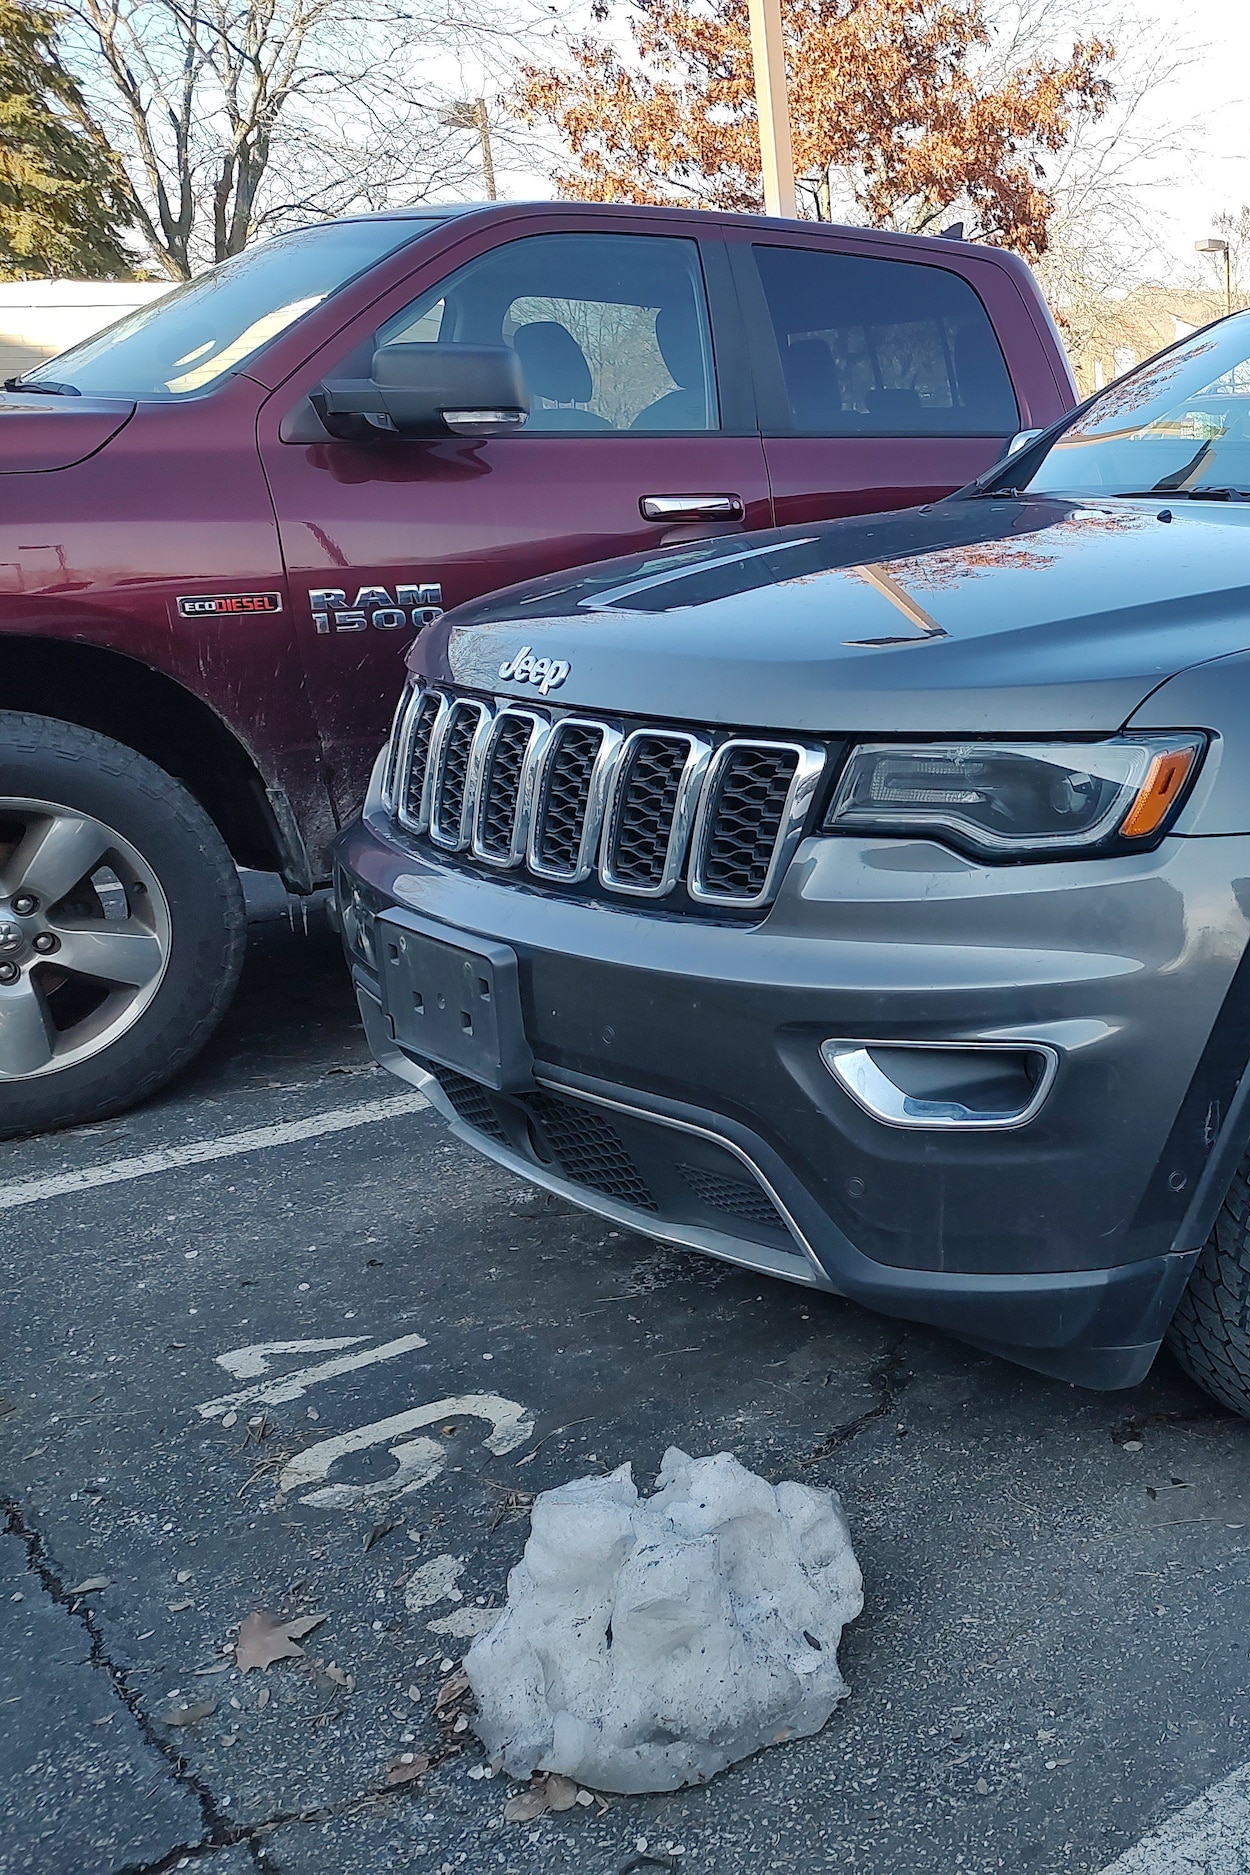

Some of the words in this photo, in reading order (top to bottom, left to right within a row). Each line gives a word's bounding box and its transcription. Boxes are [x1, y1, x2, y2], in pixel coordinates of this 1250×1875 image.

[184, 597, 275, 612] ECODIESEL
[308, 583, 444, 611] RAM
[312, 608, 443, 634] 1500
[498, 645, 571, 696] Jeep
